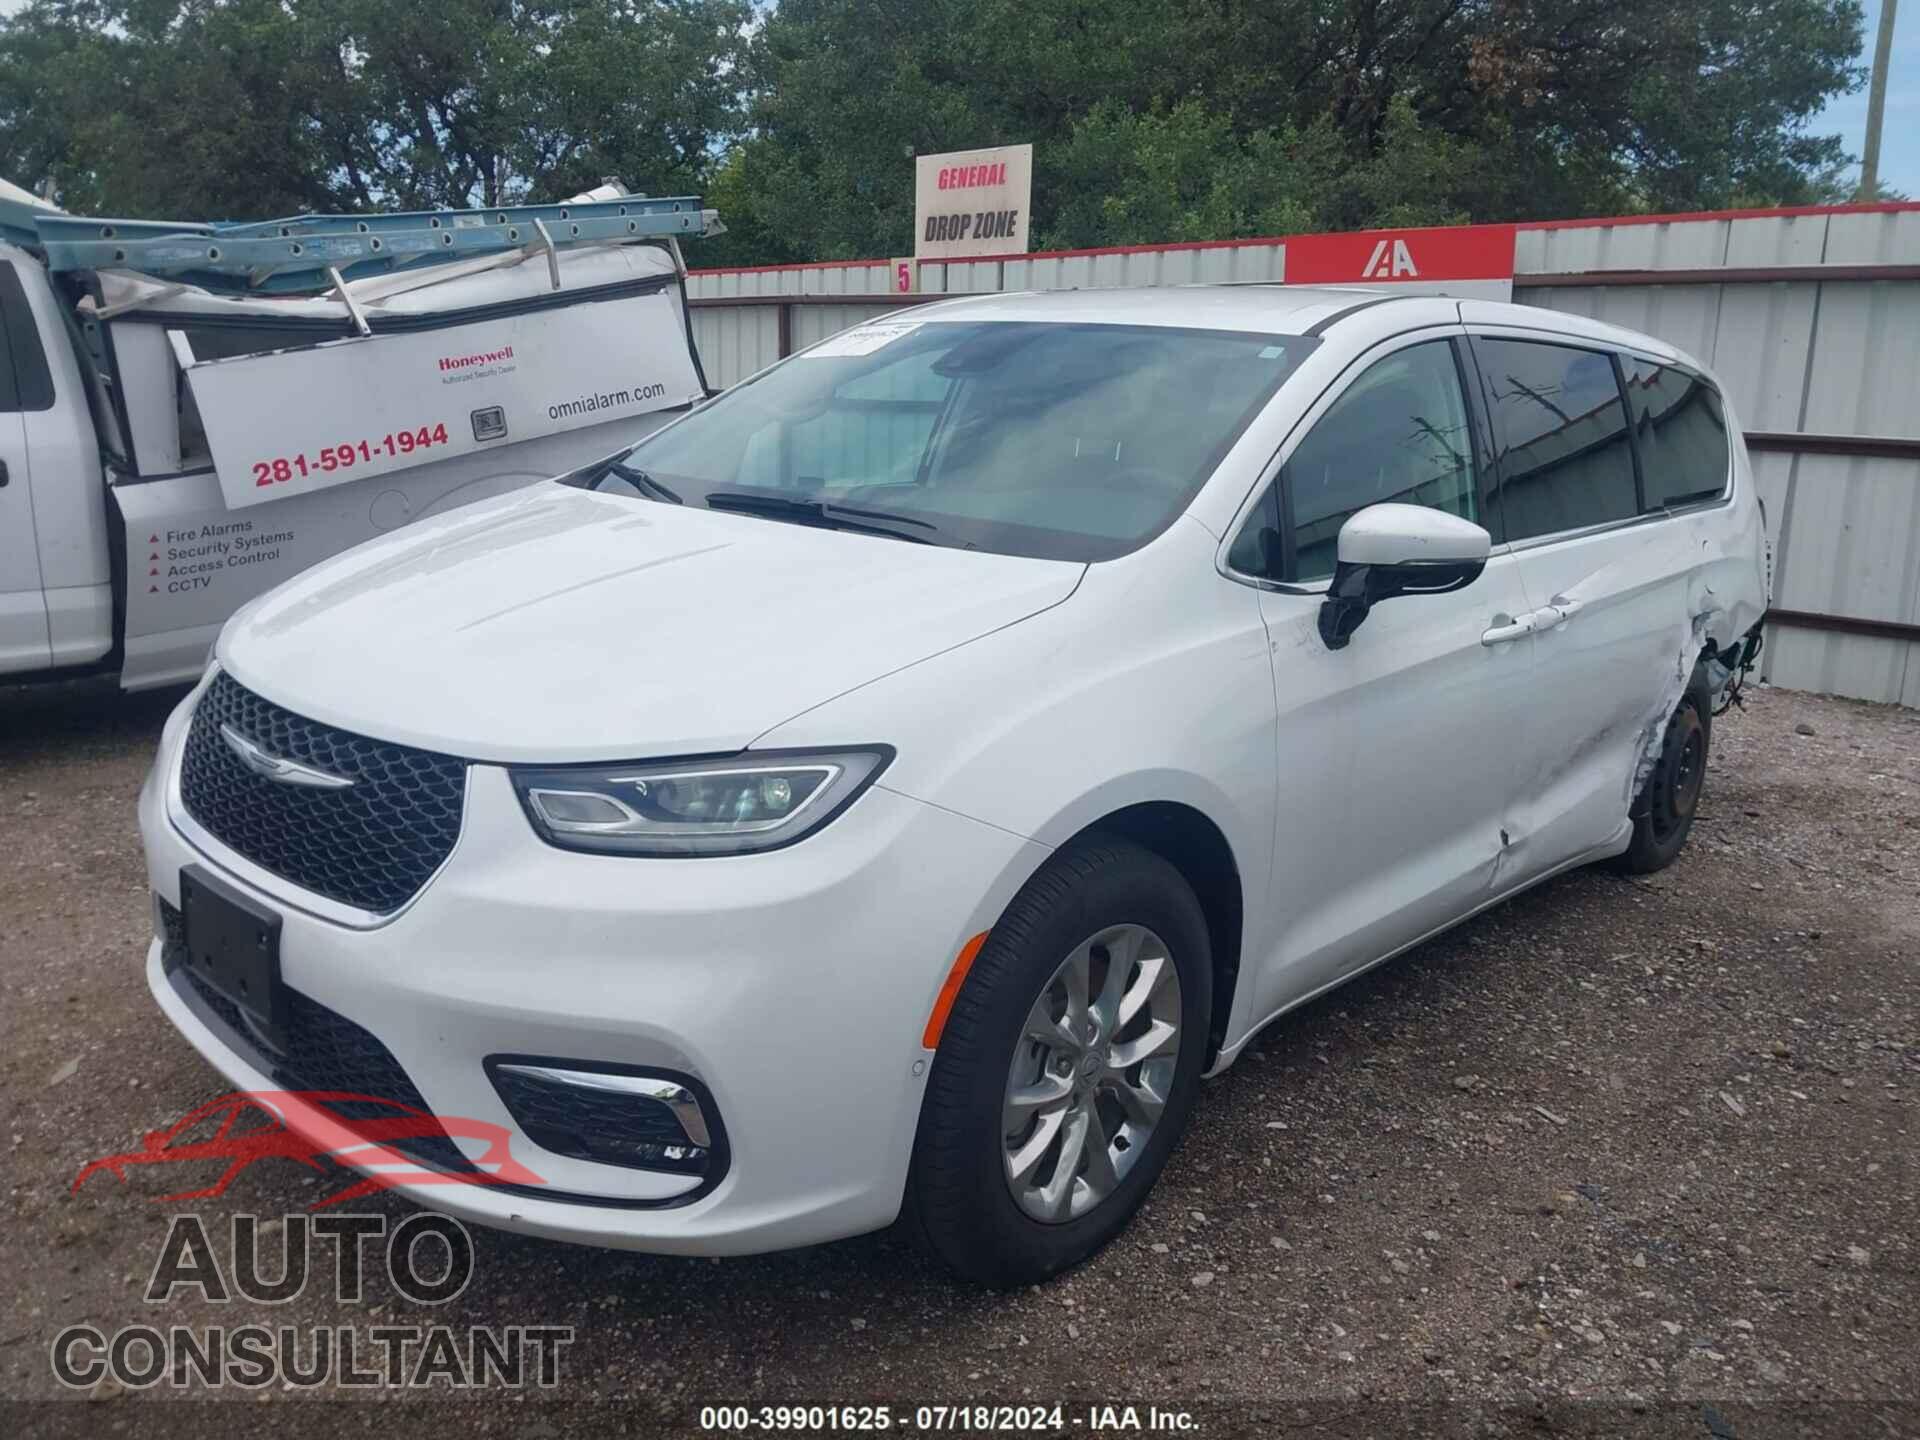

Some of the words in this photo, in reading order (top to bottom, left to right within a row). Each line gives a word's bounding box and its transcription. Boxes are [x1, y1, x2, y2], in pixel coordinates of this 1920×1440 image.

[938, 163, 1006, 190] GENERAL
[924, 213, 971, 242] DROP
[972, 210, 1018, 239] ZONE
[898, 263, 910, 293] 5
[438, 346, 514, 370] Honeywell
[548, 382, 665, 420] omnialarm.com
[253, 423, 448, 487] 281-591-1944
[167, 530, 196, 543] Fire
[201, 521, 253, 538] Alarms
[168, 541, 230, 561] Security
[235, 531, 295, 550] Systems
[168, 560, 224, 577] Access
[228, 548, 281, 567] Control
[168, 576, 212, 594] CCTV
